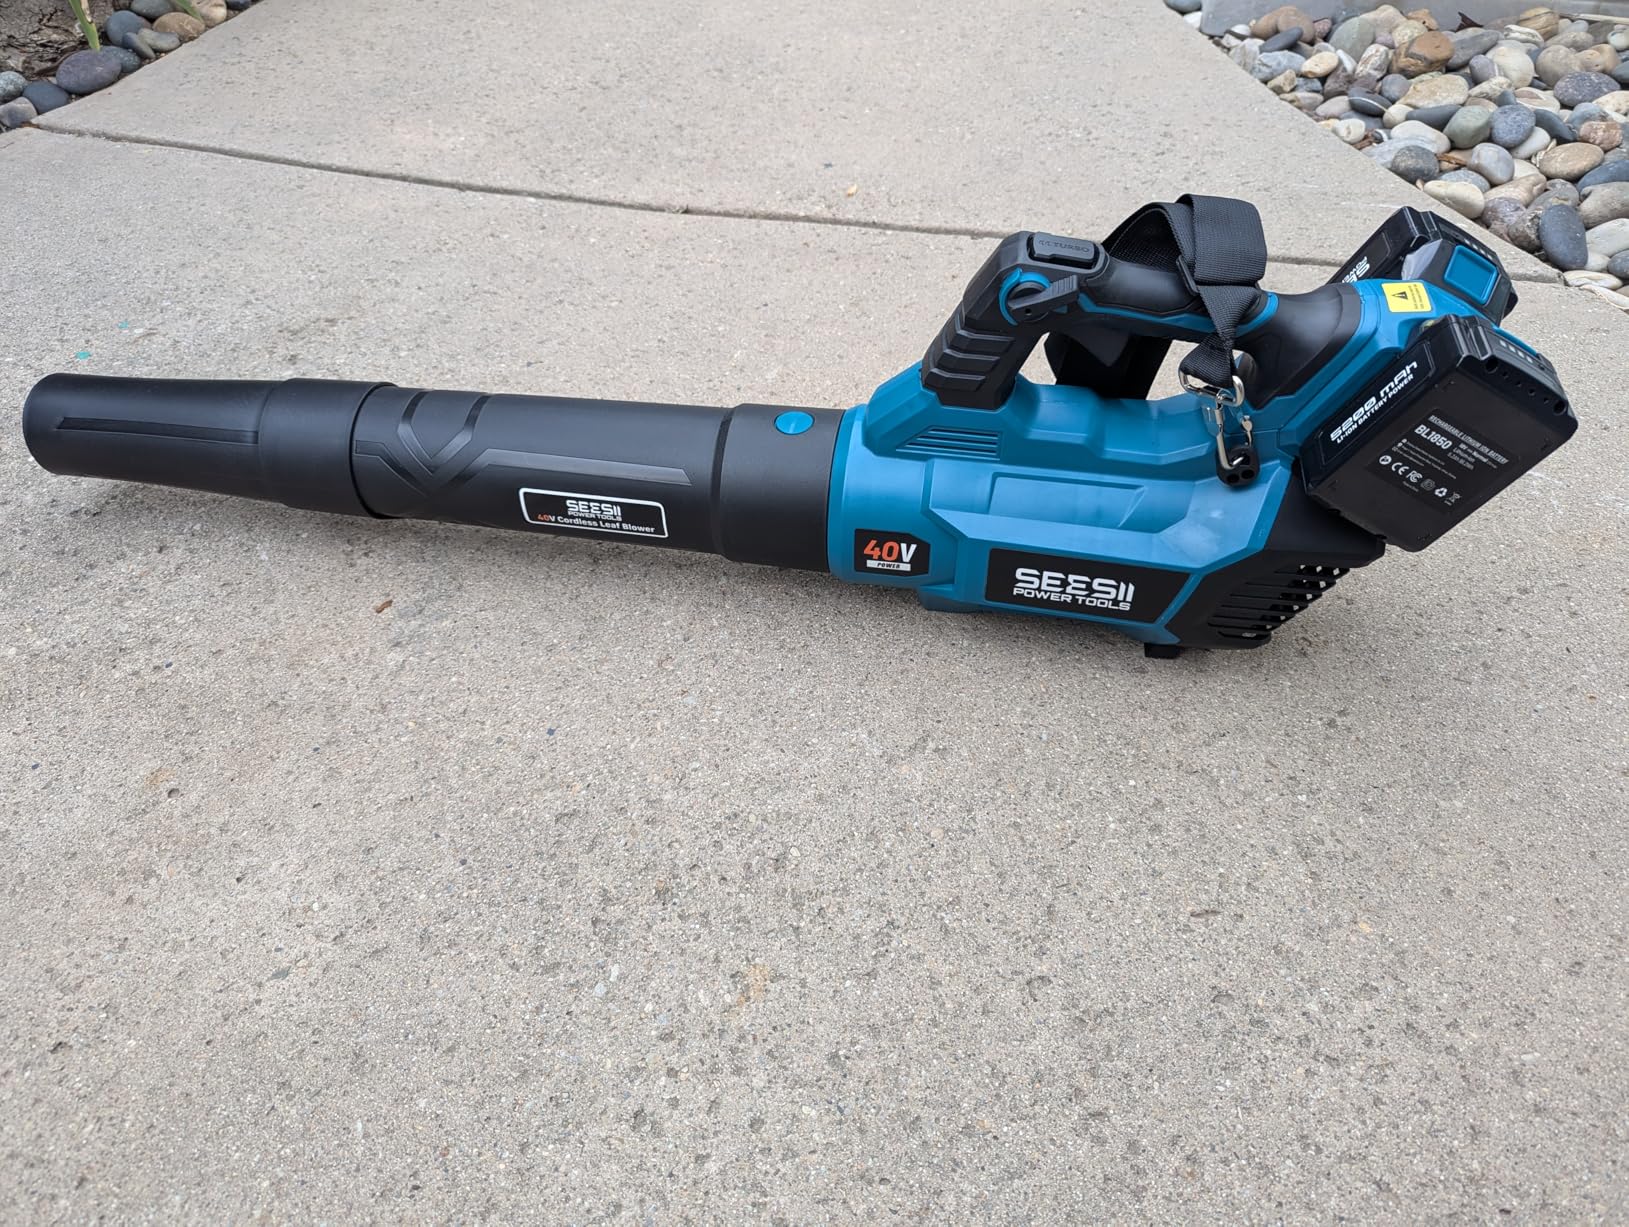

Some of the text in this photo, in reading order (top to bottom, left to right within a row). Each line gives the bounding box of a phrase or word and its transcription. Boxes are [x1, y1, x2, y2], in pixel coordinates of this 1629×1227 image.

[1054, 241, 1090, 253] TURBO
[1341, 256, 1368, 283] POWE
[1330, 361, 1418, 441] 5200 mAh
[1336, 373, 1414, 444] LI-ION BATTERY POWER
[1414, 424, 1453, 450] BL1850
[537, 513, 656, 533] 40V Cordless Leaf Blower
[567, 510, 623, 522] POWER TOOLS
[863, 539, 917, 563] 40V
[1013, 587, 1132, 611] POWER TOOLS
